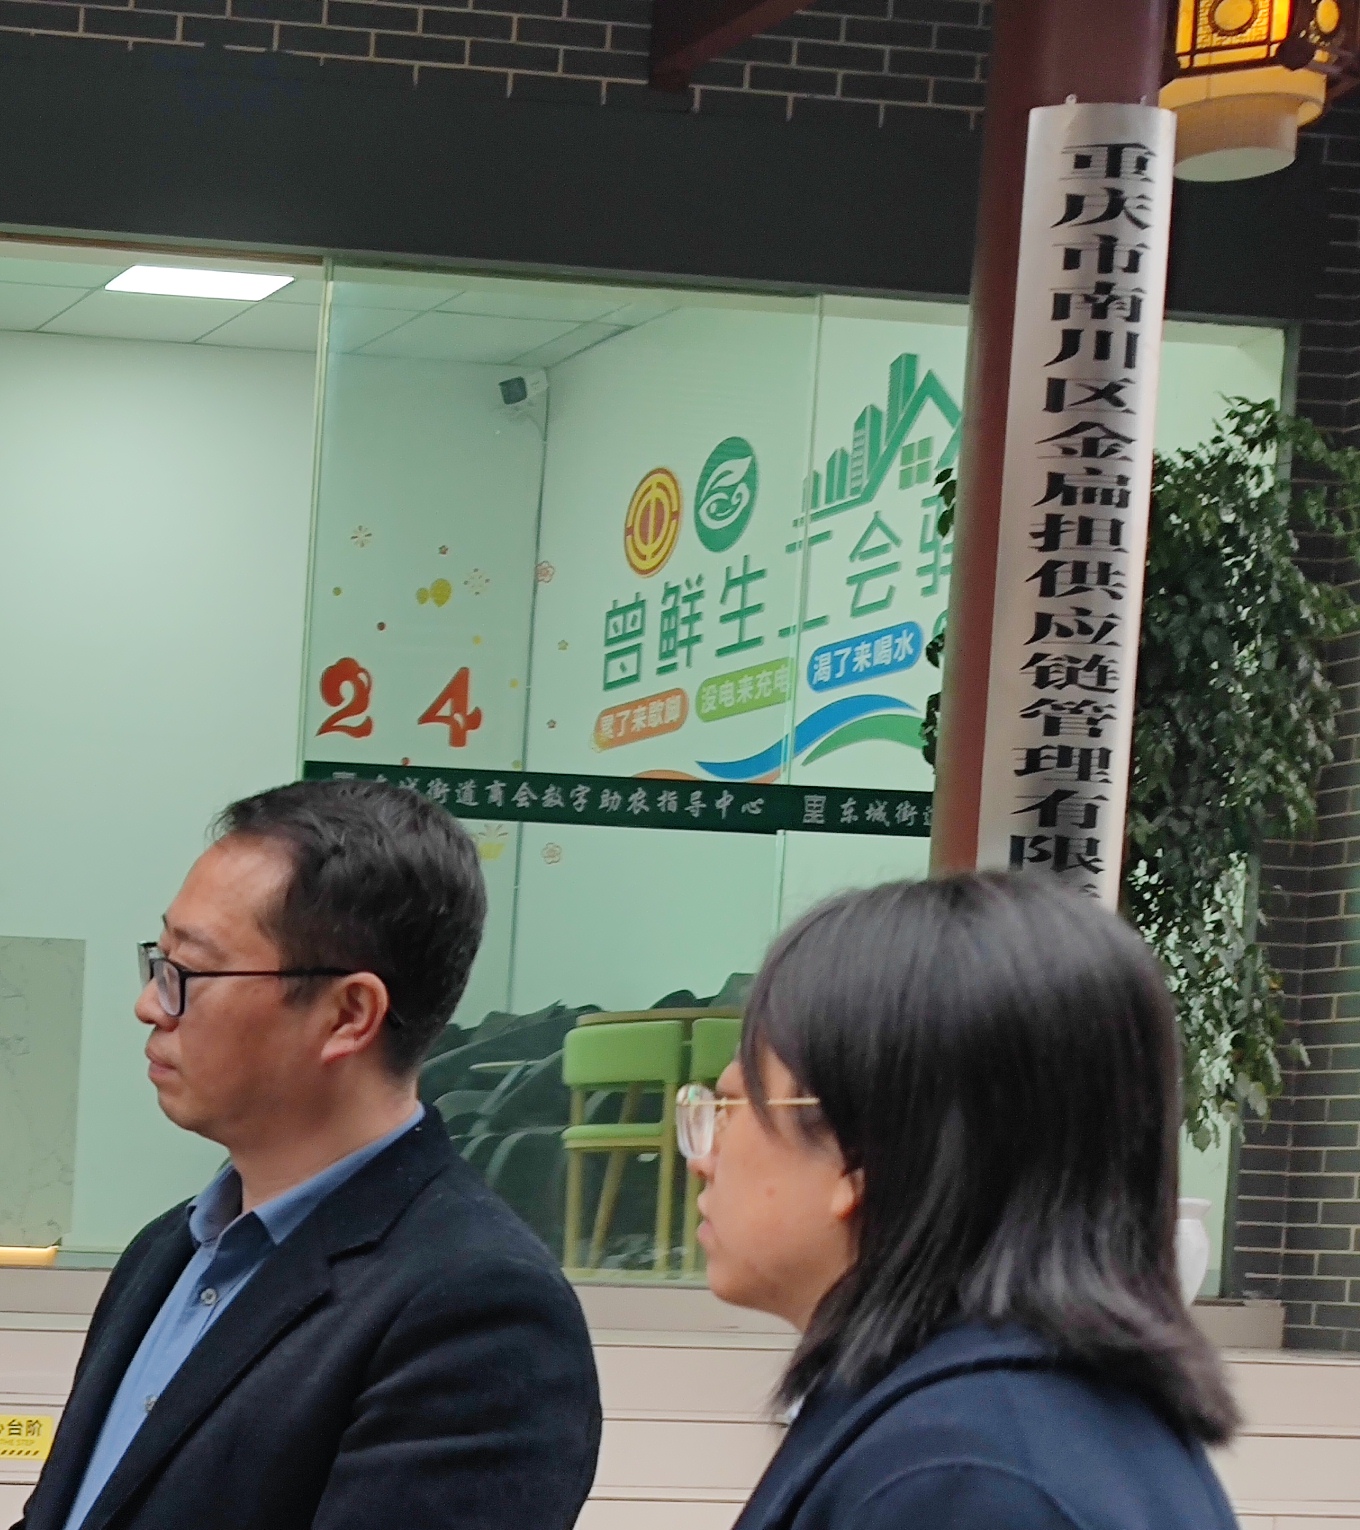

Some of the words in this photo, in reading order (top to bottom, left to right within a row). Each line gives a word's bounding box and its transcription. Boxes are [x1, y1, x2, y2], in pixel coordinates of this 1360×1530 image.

[1009, 142, 1157, 899] 重庆市南川区金扁担供应链管理有限
[812, 629, 915, 686] 渴了来喝水
[700, 665, 789, 714] 没电来充电
